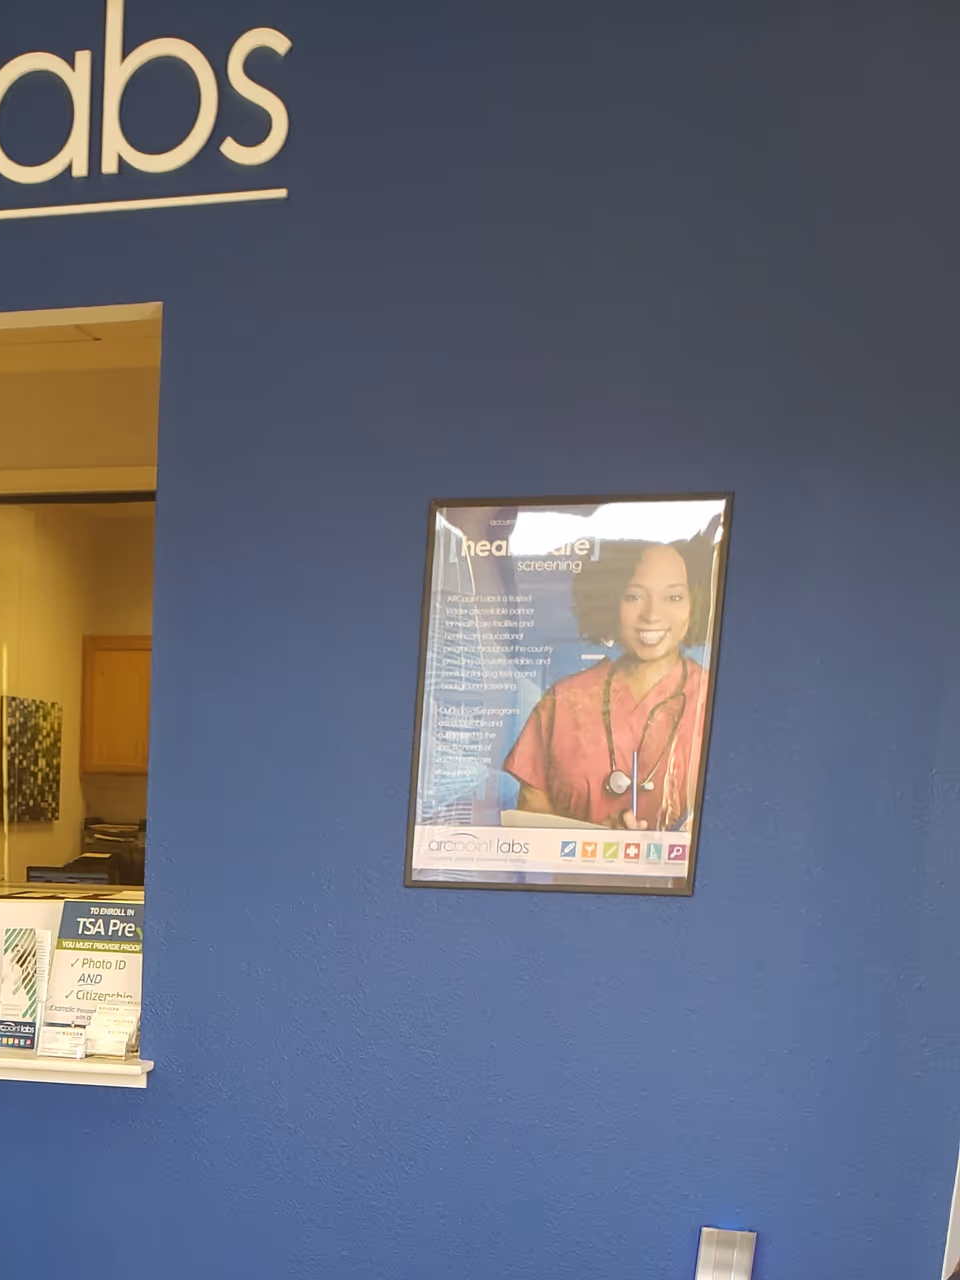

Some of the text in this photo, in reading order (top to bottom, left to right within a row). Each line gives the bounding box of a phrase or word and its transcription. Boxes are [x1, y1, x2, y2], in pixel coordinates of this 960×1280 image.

[517, 558, 583, 573] screening
[496, 838, 530, 854] labs
[90, 907, 135, 917] TO ENROLL IN
[77, 918, 136, 937] TSA Pre
[93, 942, 120, 951] PROVIDE
[81, 957, 127, 971] Photo ID
[77, 973, 103, 985] AND
